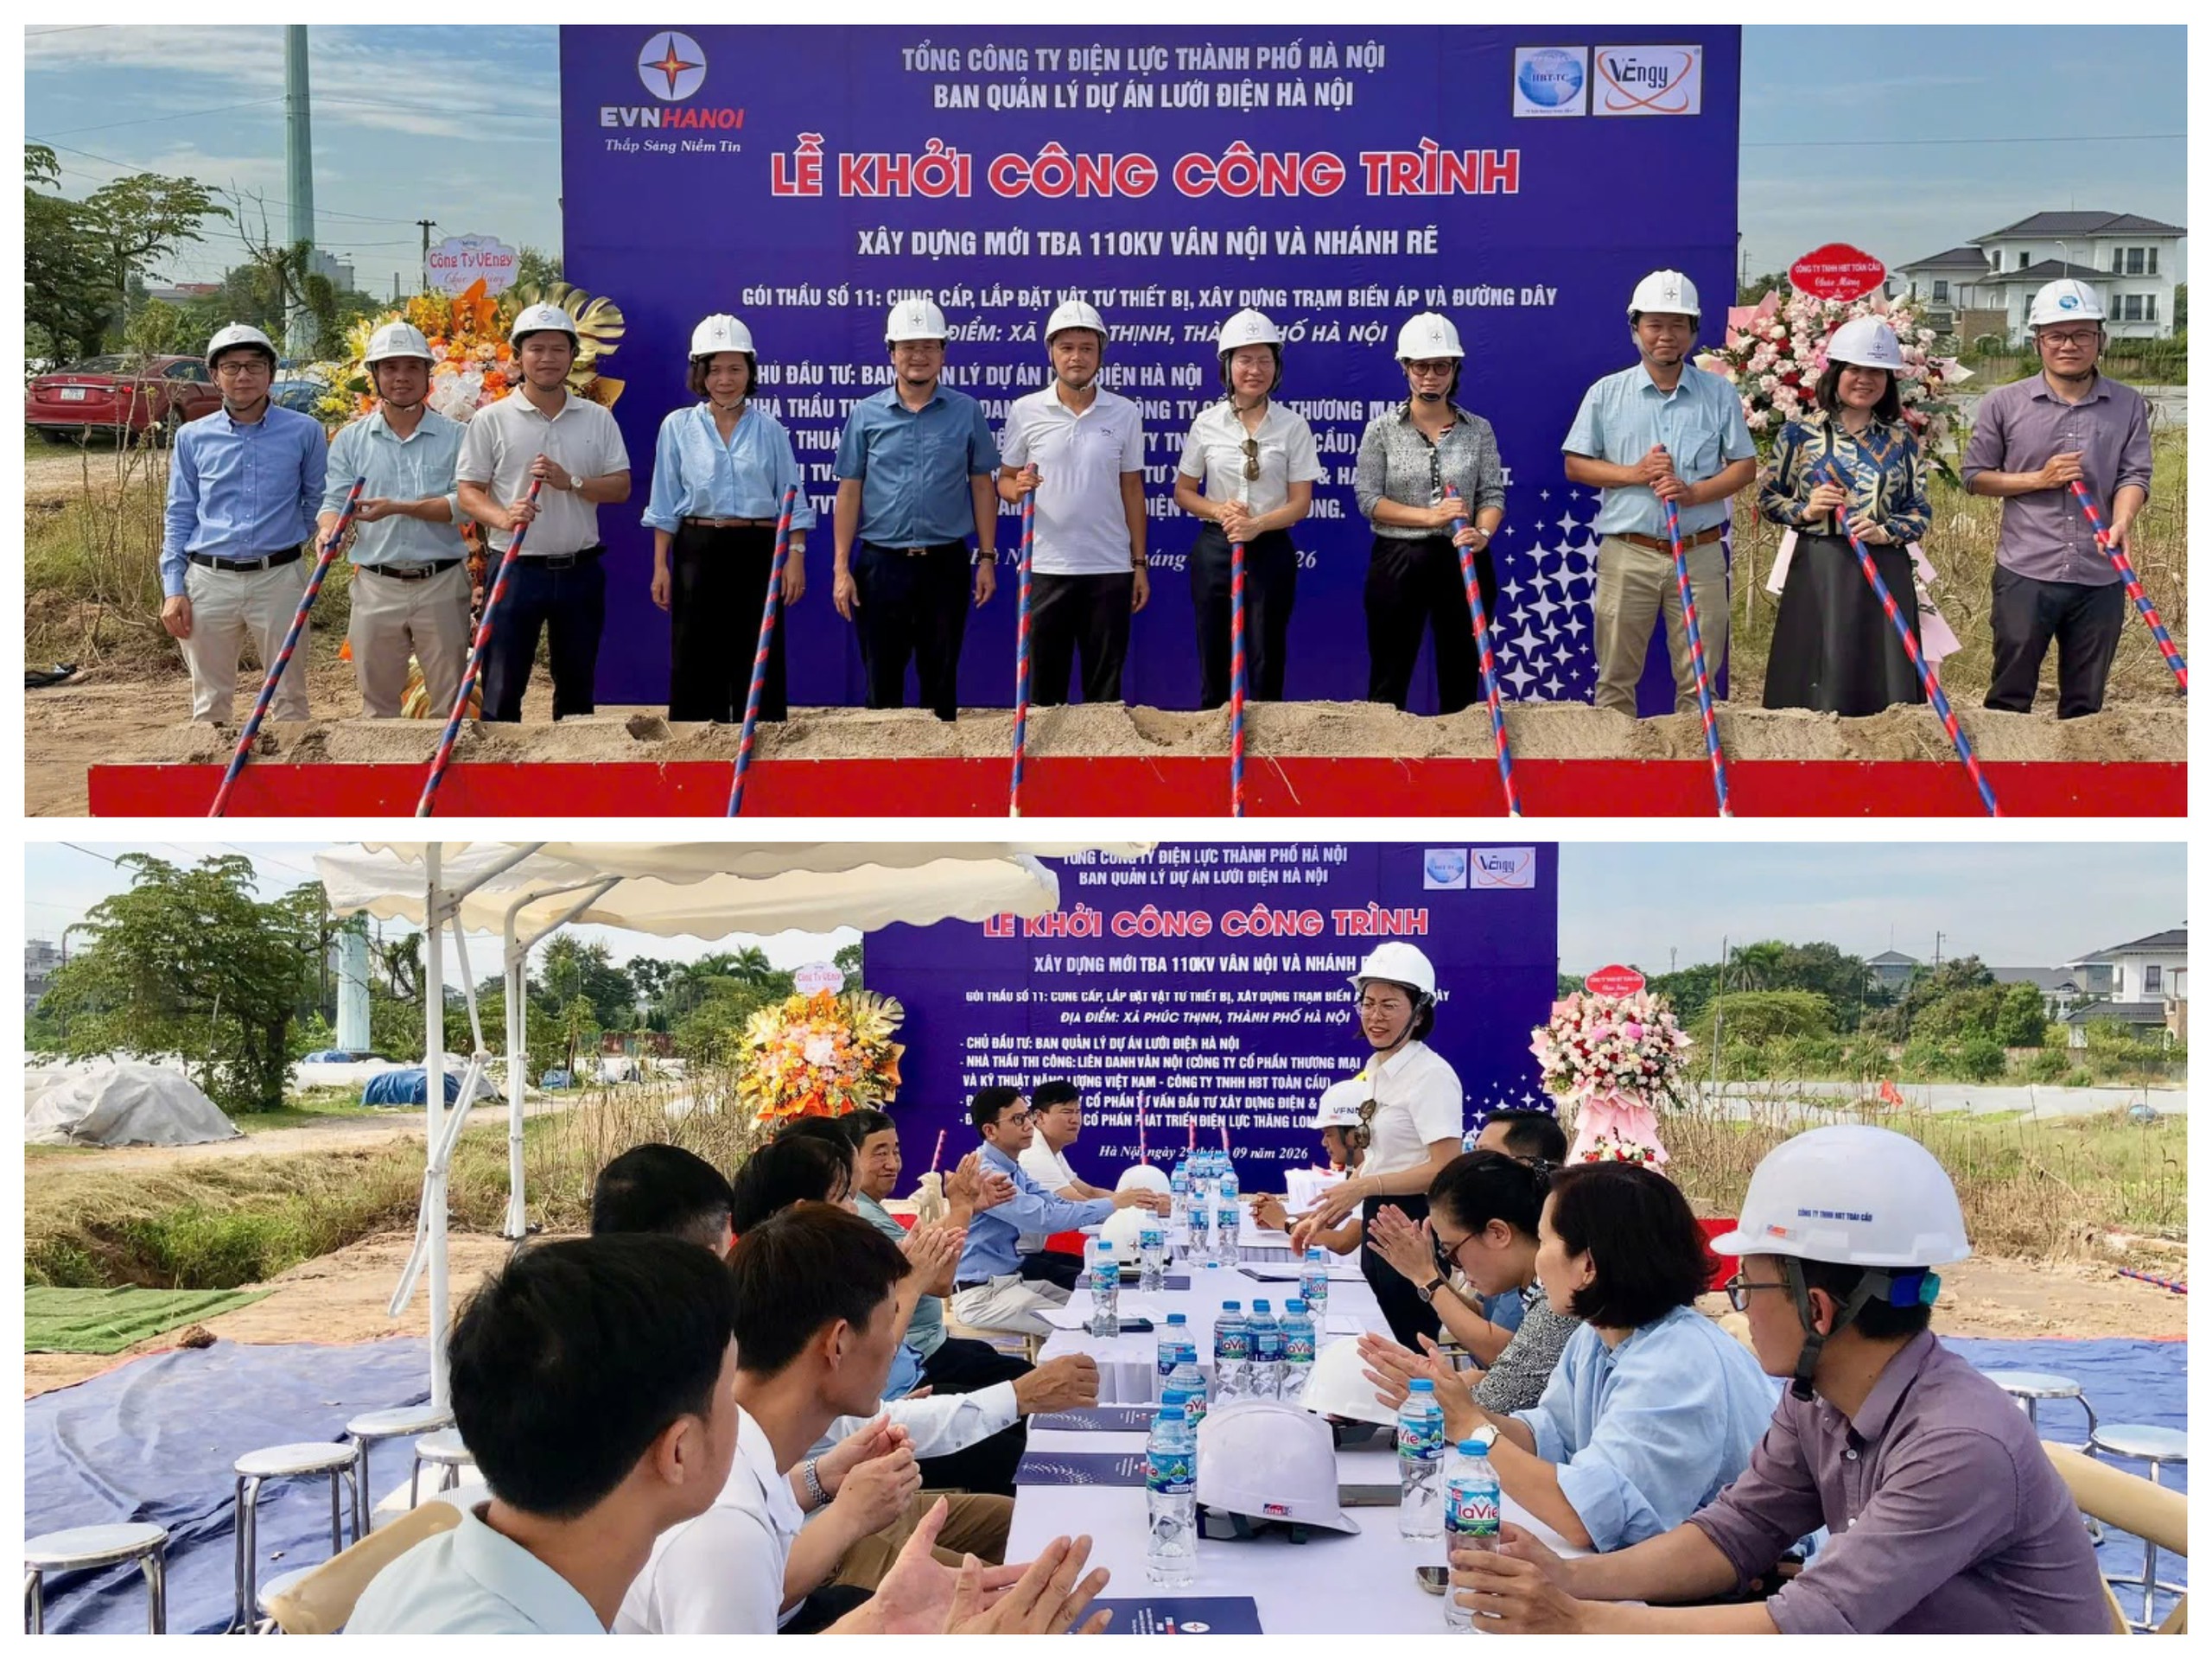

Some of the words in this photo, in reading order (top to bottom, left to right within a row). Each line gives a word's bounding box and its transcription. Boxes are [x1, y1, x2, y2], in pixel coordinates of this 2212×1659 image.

[902, 39, 960, 71] TỔNG
[968, 44, 1028, 71] CÔNG
[1035, 48, 1062, 71] TY
[1068, 44, 1120, 76] ĐIỆN
[1128, 46, 1168, 76] LỰC
[1175, 42, 1249, 70] THÀNH
[1257, 38, 1303, 69] PHỐ
[1309, 41, 1338, 68] HÀ
[1346, 41, 1385, 73] NỘI
[934, 85, 979, 108] BAN
[987, 77, 1046, 111] QUẢN
[1054, 79, 1079, 108] LÝ
[1086, 82, 1119, 113] DỰ
[1122, 79, 1153, 108] ÁN
[1160, 79, 1209, 108] LƯỚI
[1217, 78, 1268, 112] ĐIỆN
[1276, 78, 1306, 106] HÀ
[1314, 77, 1353, 111] NỘI
[601, 106, 744, 130] EVNHANOI
[720, 139, 741, 153] Tin
[771, 132, 824, 197] LỄ
[838, 137, 971, 197] KHỞI
[987, 142, 1159, 198] CÔNG
[1173, 140, 1346, 197] CÔNG
[1359, 136, 1520, 196] TRÌNH
[858, 227, 903, 256] XÂY
[912, 231, 976, 260] DỰNG
[985, 227, 1031, 256] MỚI
[1037, 232, 1082, 256] TBA
[1090, 232, 1164, 256] 110KV
[1170, 226, 1217, 256] VÂN
[1226, 226, 1267, 260] NỘI
[1274, 226, 1306, 255] VÀ
[1314, 226, 1398, 255] NHÁNH
[1407, 226, 1439, 254] RẼ
[742, 285, 772, 305] GÓI
[776, 283, 821, 305] THẦU
[827, 282, 849, 305] SỐ
[855, 289, 880, 305] 11:
[938, 282, 976, 308] CẤP,
[982, 283, 1014, 306] LẮP
[1018, 285, 1051, 310] ĐẶT
[1093, 289, 1117, 306] TƯ
[1120, 283, 1166, 306] THIẾT
[1172, 289, 1194, 310] BỊ,
[1199, 285, 1234, 306] XÂY
[1239, 288, 1287, 309] DỰNG
[1294, 289, 1342, 310] TRẠM
[1348, 283, 1389, 306] BIẾN
[1395, 285, 1420, 306] ÁP
[1425, 285, 1446, 306] VÀ
[1452, 283, 1515, 306] ĐƯỜNG
[1521, 284, 1557, 305] DÂY
[948, 316, 1002, 341] ĐIỂM:
[1007, 321, 1037, 340] XÃ
[1109, 324, 1175, 346] THỊNH,
[1312, 321, 1340, 341] HÀ
[1348, 321, 1389, 346] NỘI
[786, 359, 823, 385] ĐẦU
[829, 364, 855, 385] TƯ:
[960, 361, 982, 385] LÝ
[986, 365, 1013, 389] DỰ
[1016, 362, 1041, 385] ÁN
[1141, 362, 1166, 385] HÀ
[1171, 364, 1203, 390] NỘI
[787, 391, 835, 418] THẦU
[1176, 400, 1195, 419] TY
[1158, 847, 1191, 867] ĐIỆN
[1194, 849, 1219, 867] LỰC
[1223, 846, 1266, 862] THÀNH
[1270, 842, 1299, 862] PHỐ
[1323, 844, 1347, 865] NỘI
[1079, 872, 1106, 885] BAN
[1111, 869, 1146, 886] QUẢN
[1150, 869, 1166, 885] LÝ
[1170, 870, 1190, 887] DỰ
[1192, 868, 1209, 884] ÁN
[1213, 868, 1243, 884] LƯỚI
[1248, 867, 1278, 887] ĐIỆN
[1282, 867, 1300, 883] HÀ
[1306, 867, 1328, 886] NỘI
[1024, 902, 1103, 938] KHỞI
[1111, 904, 1212, 938] CÔNG
[1221, 902, 1324, 937] CÔNG
[1332, 900, 1428, 936] TRÌNH
[1034, 954, 1062, 972] XÂY
[1066, 956, 1104, 976] DỰNG
[1109, 954, 1137, 972] MỚI
[1140, 957, 1167, 972] TBA
[1172, 957, 1214, 972] 110KV
[1219, 954, 1249, 971] VÂN
[1254, 954, 1277, 975] NỘI
[1282, 953, 1300, 971] VÀ
[1306, 953, 1356, 971] NHÁNH
[1060, 1012, 1080, 1026] ĐỊA
[1085, 1007, 1120, 1023] ĐIỂM:
[1143, 1009, 1179, 1023] PHÚC
[1183, 1012, 1223, 1026] THỊNH,
[1227, 1009, 1268, 1023] THÀNH
[1272, 1007, 1303, 1022] PHỐ
[1304, 1009, 1322, 1022] HÀ
[1325, 1009, 1351, 1026] NỘI
[1035, 1037, 1058, 1049] BAN
[1094, 1035, 1105, 1049] LÝ
[1201, 1035, 1217, 1049] HÀ
[1220, 1035, 1239, 1052] NỘI
[966, 1053, 989, 1068] NHÀ
[1022, 1056, 1039, 1067] THI
[1042, 1053, 1076, 1068] CÔNG:
[1077, 1053, 1102, 1068] LIÊN
[1105, 1056, 1135, 1068] DANH
[1223, 1056, 1236, 1069] TY
[1338, 1057, 1361, 1072] MẠI
[1134, 1076, 1156, 1088] NAM
[1200, 1076, 1212, 1089] TY
[1216, 1076, 1245, 1089] TNHH
[1219, 1094, 1242, 1109] XÂY
[1245, 1096, 1274, 1111] DỰNG
[1278, 1093, 1305, 1112] ĐIỆN
[1308, 1098, 1317, 1109] &
[1230, 1114, 1250, 1129] LỰC
[1098, 1145, 1117, 1157] Hà
[1233, 1147, 1248, 1159] 09
[1279, 1147, 1308, 1160] 2026
[1459, 1503, 1498, 1519] laVie
